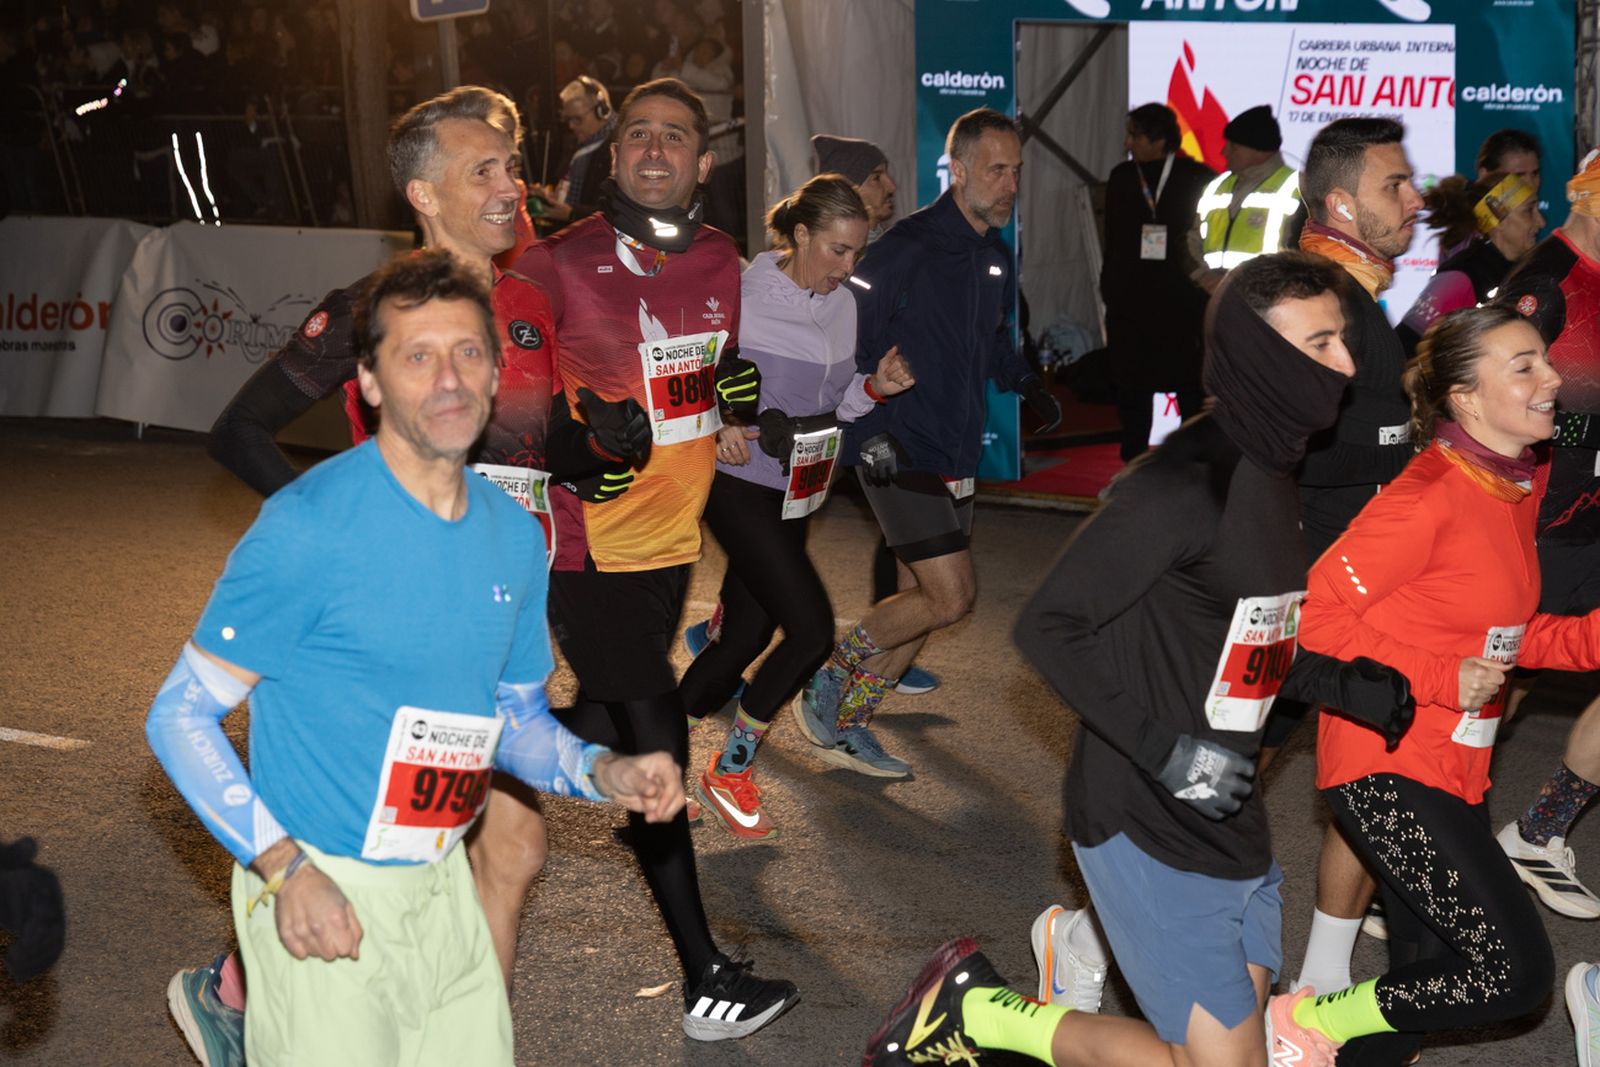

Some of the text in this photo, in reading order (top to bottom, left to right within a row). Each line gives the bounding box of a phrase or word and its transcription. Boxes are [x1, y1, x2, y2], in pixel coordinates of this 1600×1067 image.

[1298, 39, 1351, 52] CARRERA
[1353, 41, 1401, 53] URBANA
[1296, 56, 1370, 72] NOCHE DE
[921, 70, 1005, 89] calderón
[1291, 74, 1366, 106] SAN
[1462, 83, 1563, 104] calderón
[0, 291, 111, 331] lderó
[665, 346, 694, 361] NOCHE
[655, 361, 676, 376] SAN
[428, 730, 489, 749] NOCHE DE
[406, 745, 437, 763] SAN
